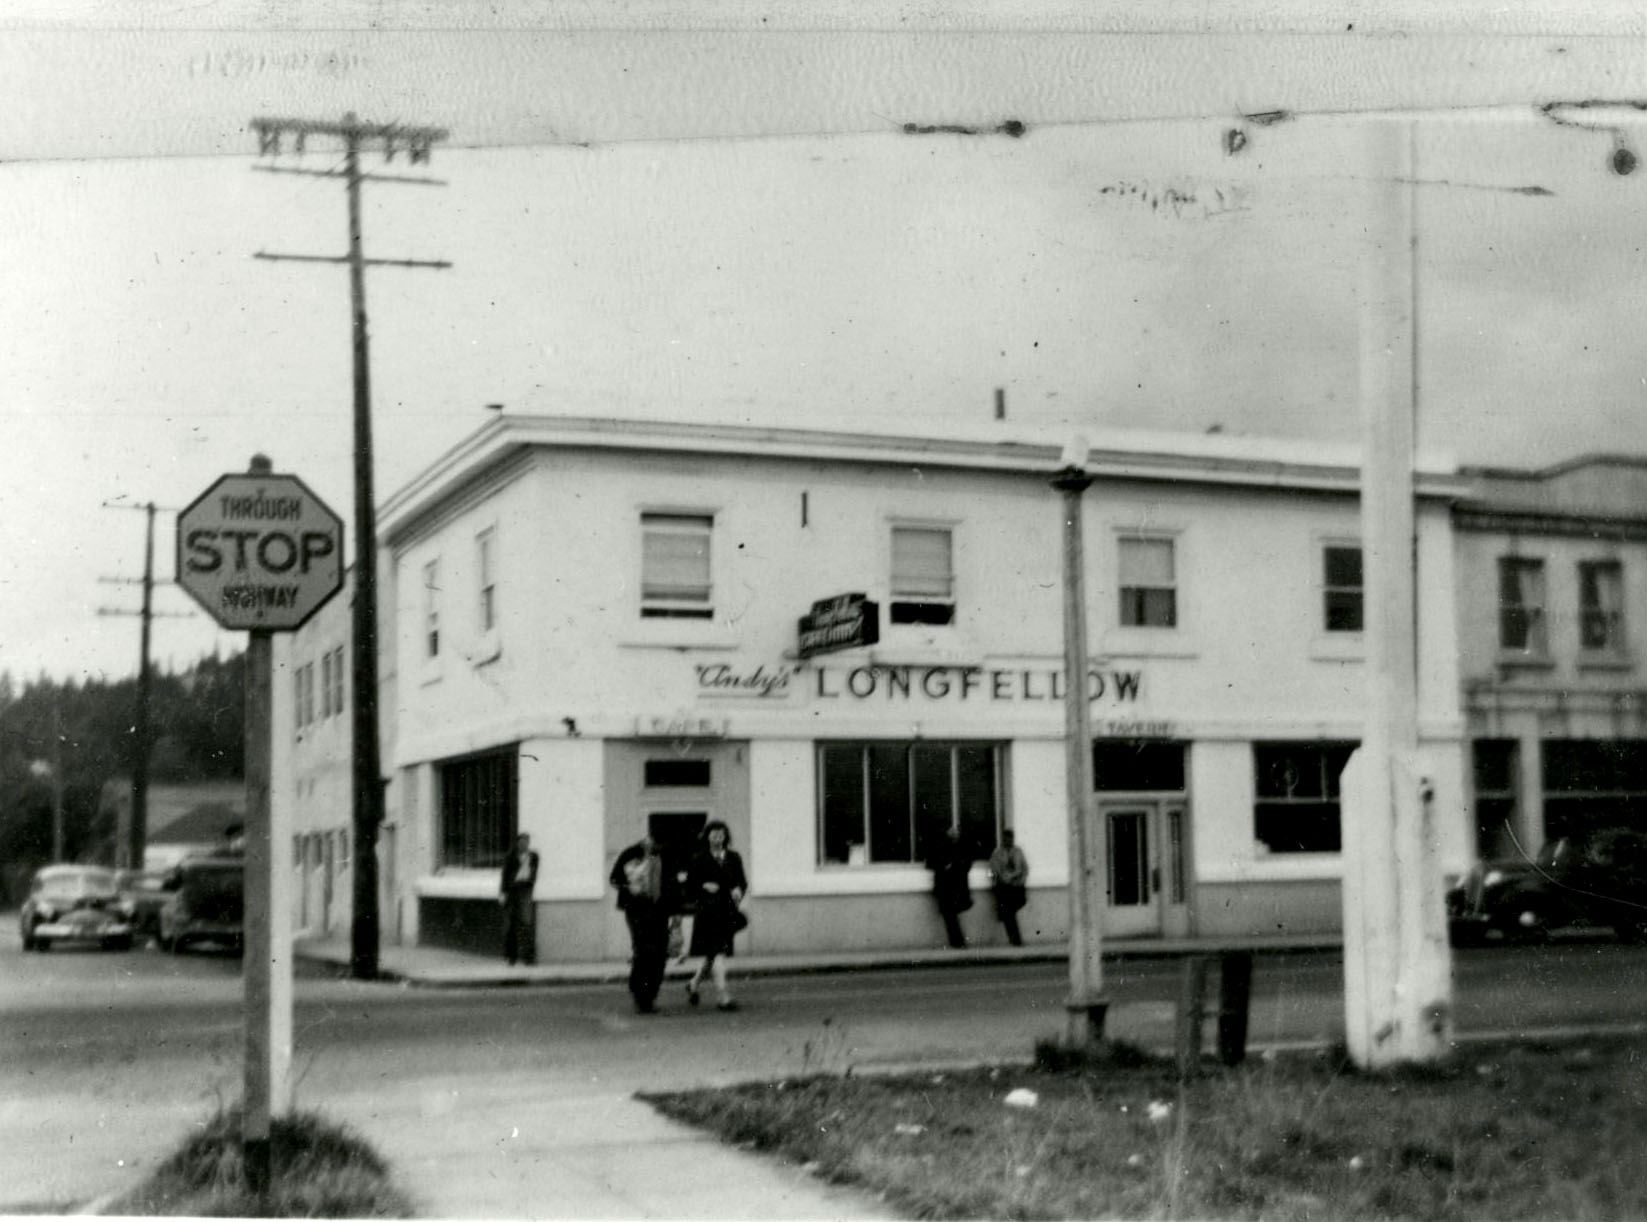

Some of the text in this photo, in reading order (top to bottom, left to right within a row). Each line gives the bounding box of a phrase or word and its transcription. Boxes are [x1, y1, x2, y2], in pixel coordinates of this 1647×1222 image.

[221, 496, 302, 520] THROUGH
[186, 530, 334, 574] STOP
[817, 666, 1141, 701] LONGFELLOW
